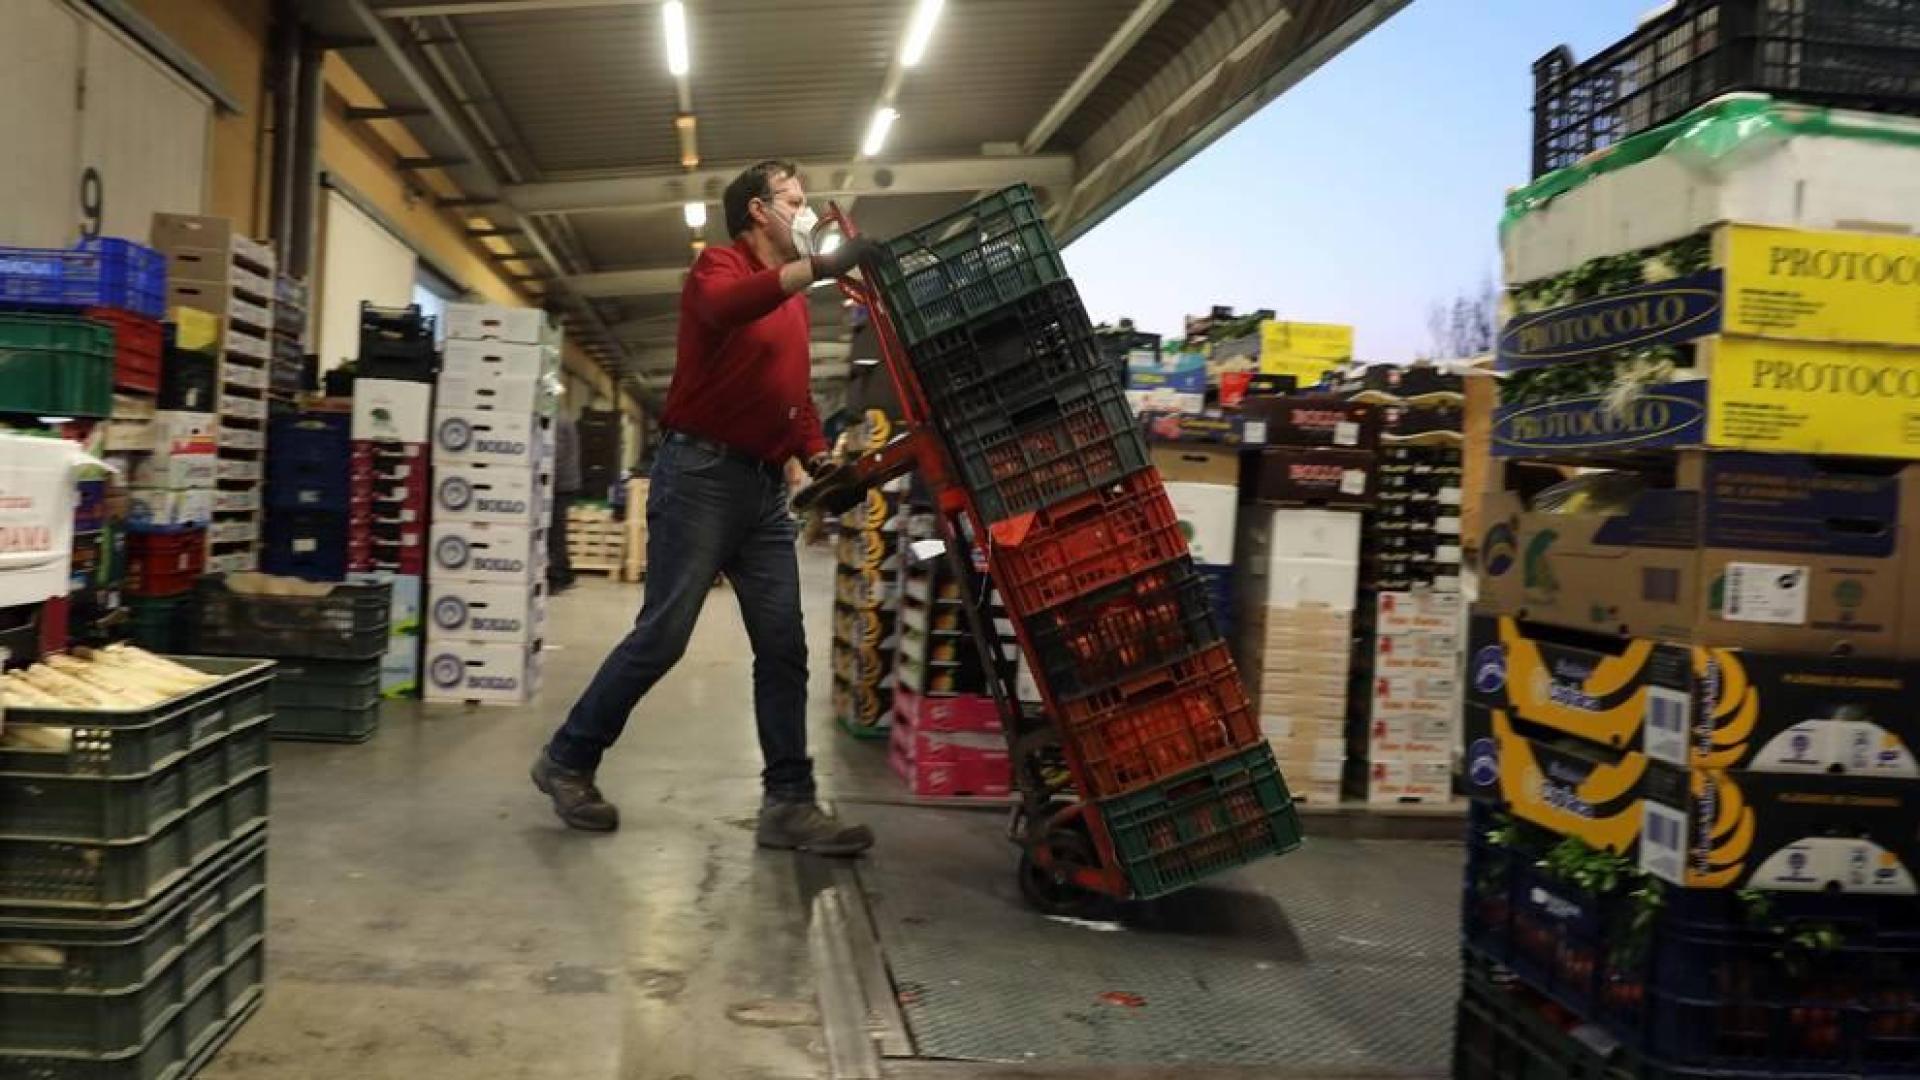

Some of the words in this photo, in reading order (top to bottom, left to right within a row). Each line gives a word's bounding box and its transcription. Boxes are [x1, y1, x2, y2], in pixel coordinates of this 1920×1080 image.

[80, 167, 102, 241] 9
[1768, 247, 1920, 286] PROTOC
[1519, 295, 1687, 352] PROTOCOLO
